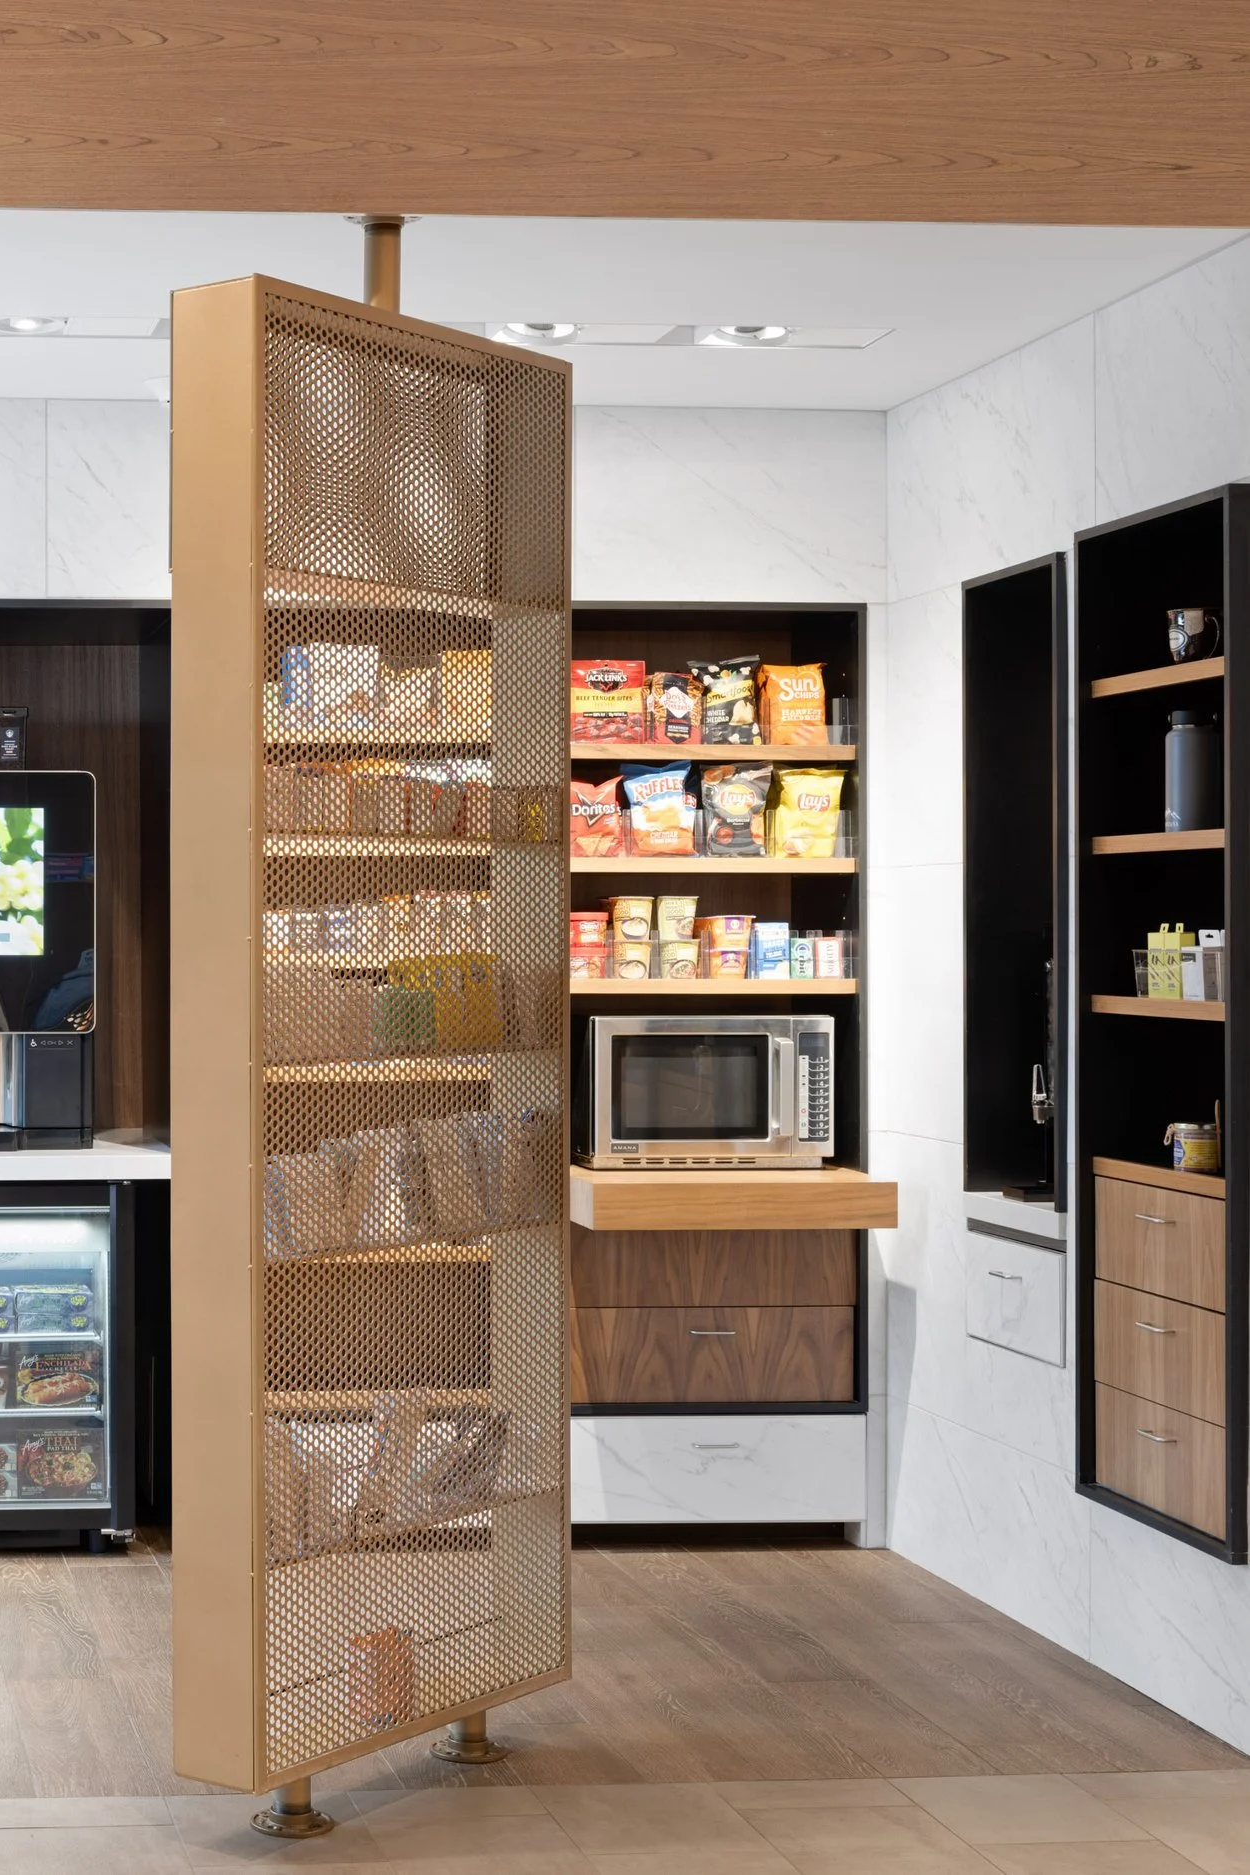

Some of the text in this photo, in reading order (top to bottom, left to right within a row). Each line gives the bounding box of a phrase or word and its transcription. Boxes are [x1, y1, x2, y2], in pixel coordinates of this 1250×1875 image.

[584, 673, 604, 682] JACK
[779, 678, 820, 701] Sun
[794, 691, 820, 699] CHIPS
[571, 803, 616, 816] Doritos
[35, 1359, 92, 1371] ENCHILADA
[22, 1438, 45, 1455] Amy's
[47, 1436, 78, 1447] THAI
